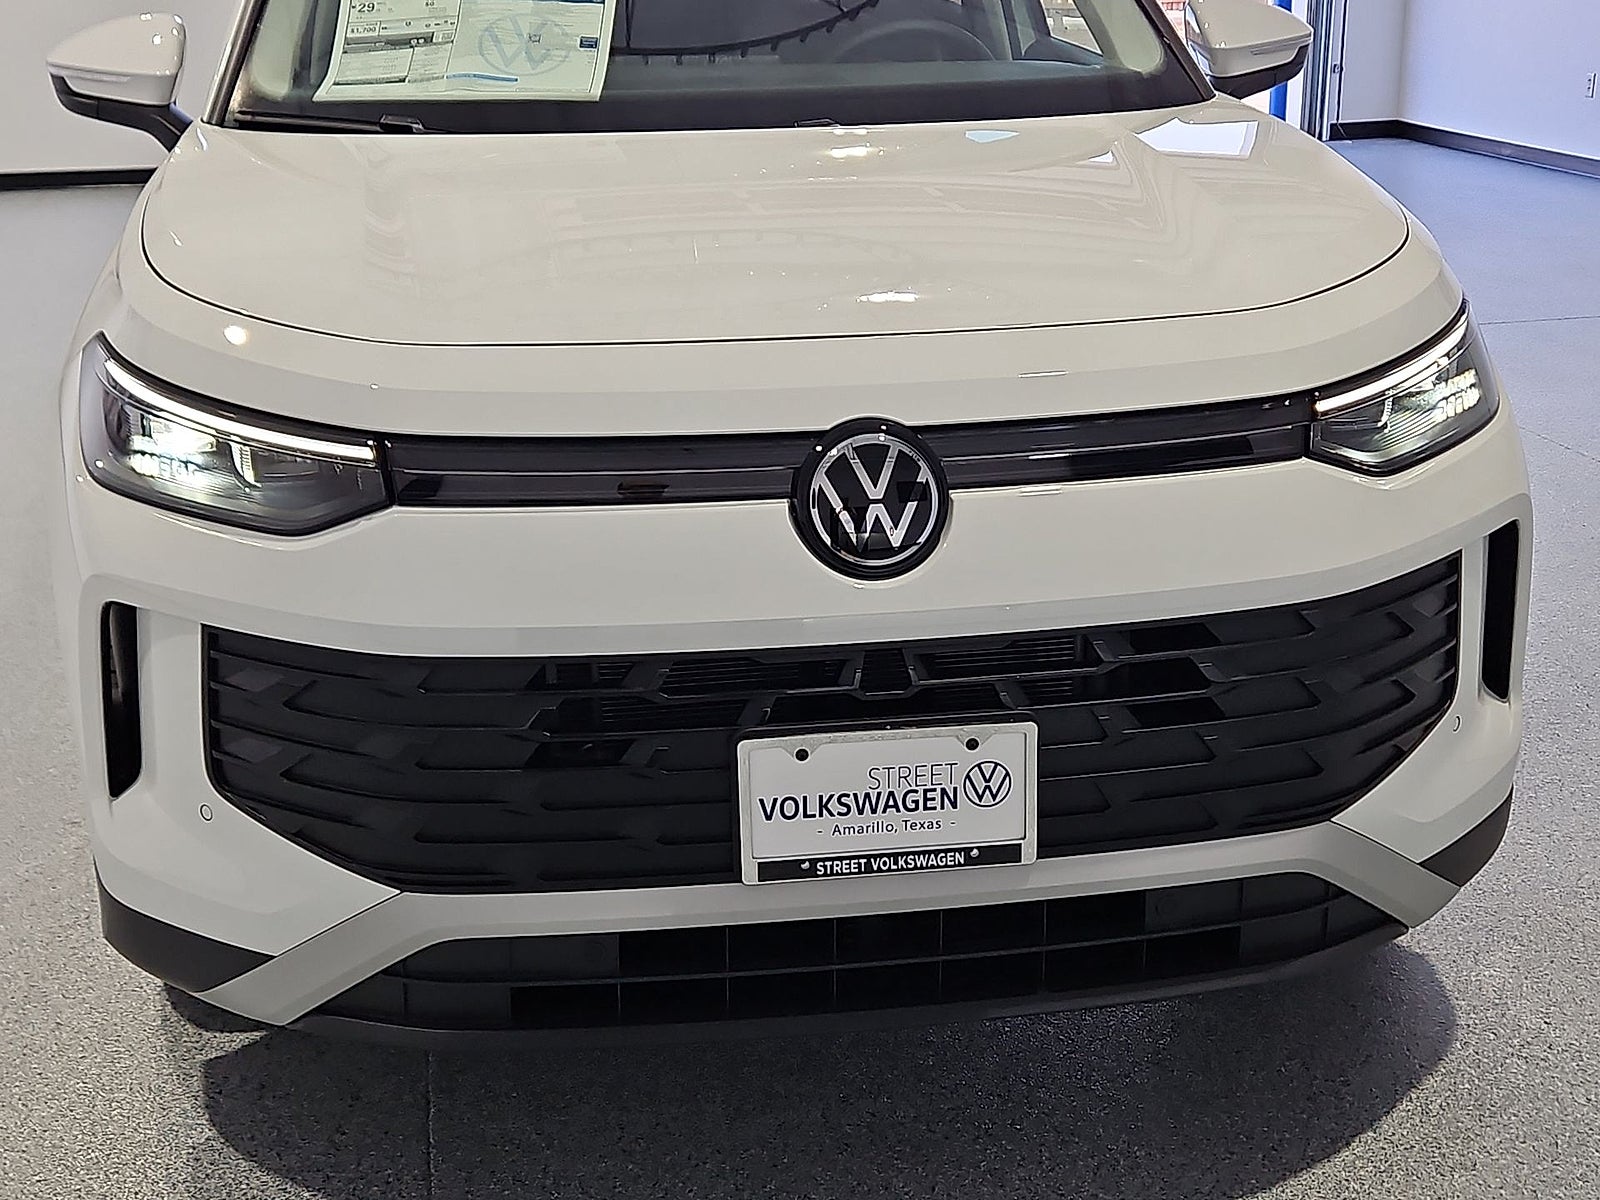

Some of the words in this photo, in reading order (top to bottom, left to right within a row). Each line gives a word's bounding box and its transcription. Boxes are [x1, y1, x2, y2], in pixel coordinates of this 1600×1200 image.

[357, 2, 376, 13] 29
[810, 435, 938, 563] VW
[868, 762, 959, 790] STREET
[758, 786, 959, 822] VOLKSWAGEN
[831, 820, 898, 837] Amarillo,
[901, 818, 942, 832] Texas
[816, 858, 867, 875] STREET
[870, 851, 965, 871] VOLKSWAGEN
